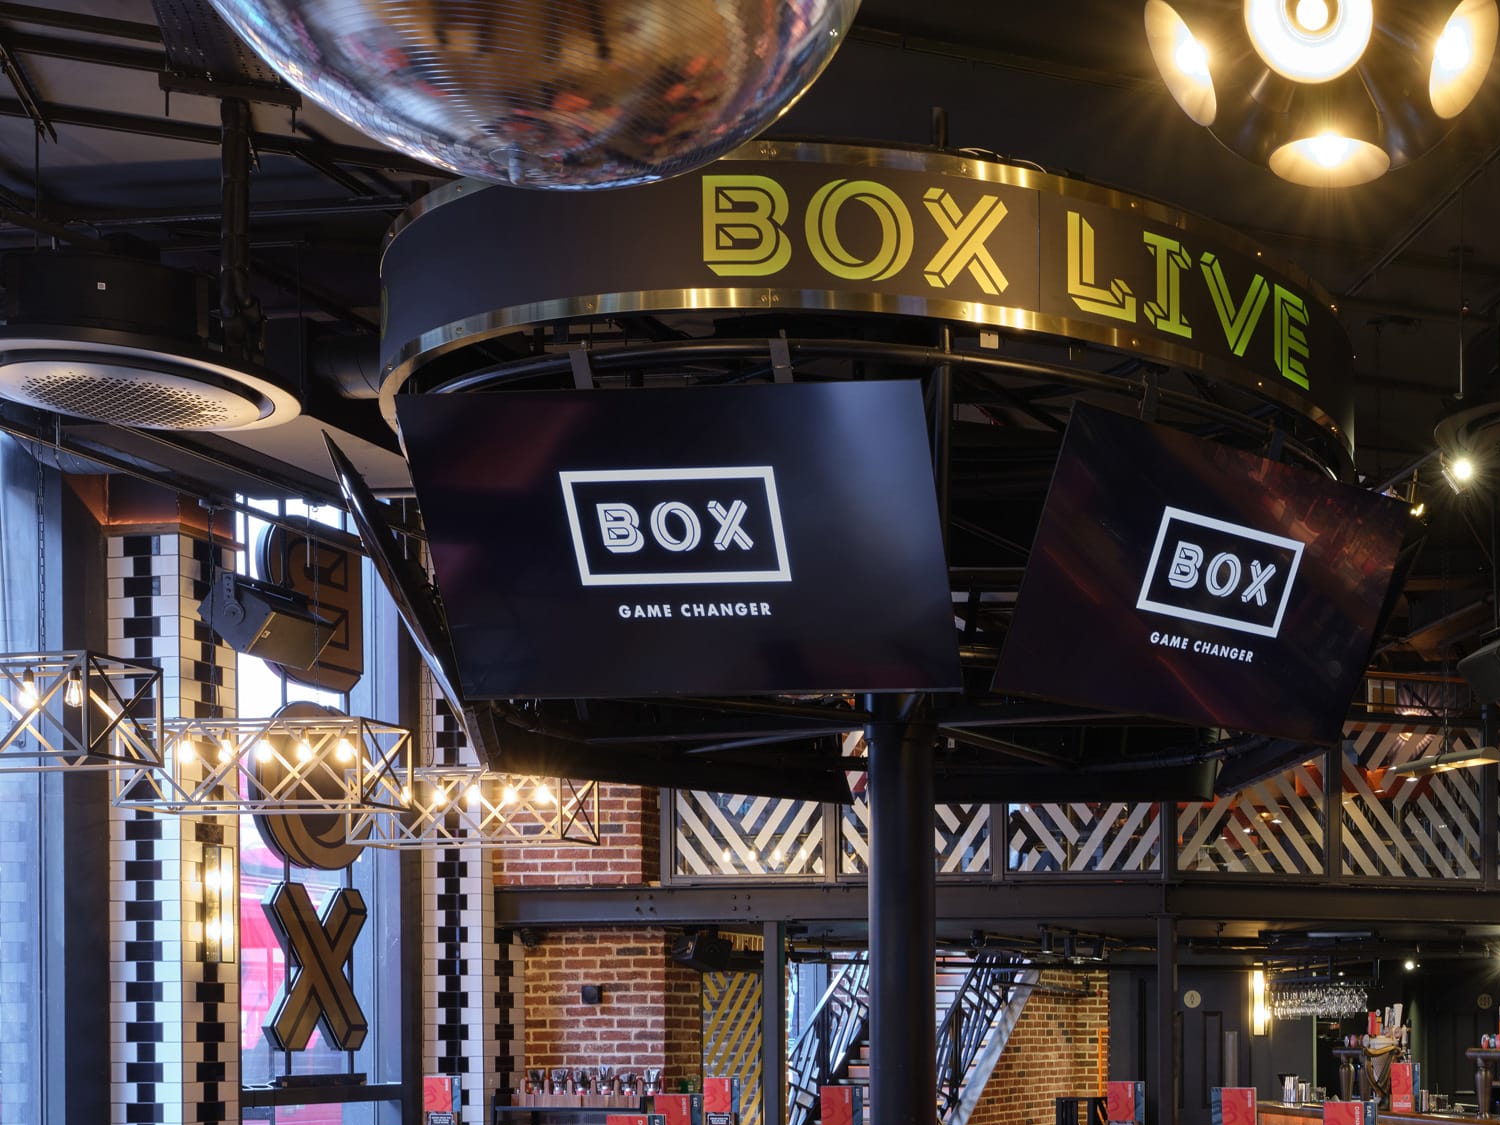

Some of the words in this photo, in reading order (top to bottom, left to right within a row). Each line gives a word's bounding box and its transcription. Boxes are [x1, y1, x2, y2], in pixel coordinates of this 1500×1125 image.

[702, 174, 1009, 296] BOX
[1065, 210, 1311, 390] LIVE
[596, 500, 754, 553] BOX
[1168, 540, 1276, 607] BOX
[618, 604, 673, 618] GAME
[680, 602, 772, 617] CHANGER
[1150, 631, 1189, 650] GAME
[1193, 641, 1254, 663] CHANGER
